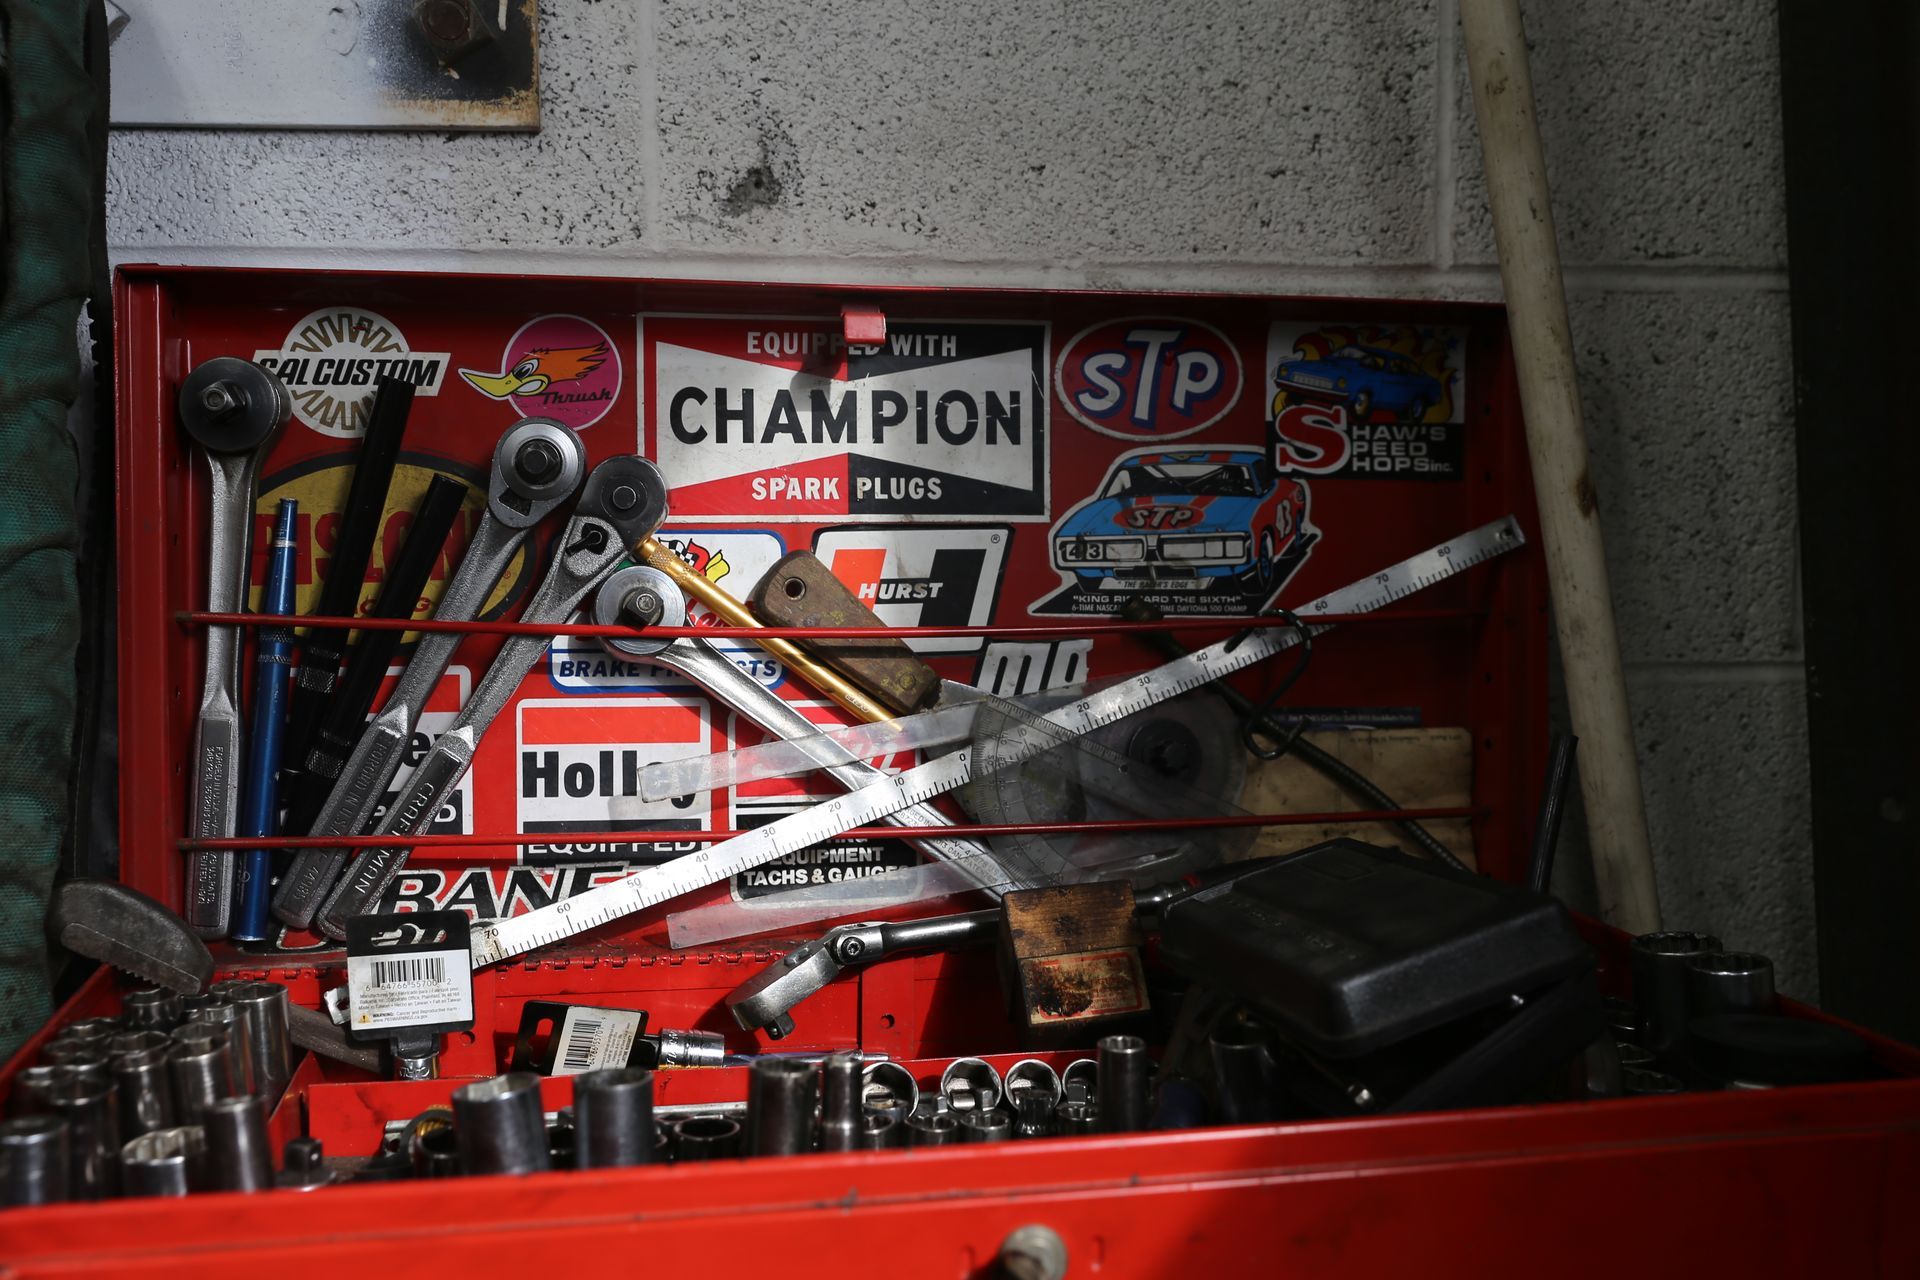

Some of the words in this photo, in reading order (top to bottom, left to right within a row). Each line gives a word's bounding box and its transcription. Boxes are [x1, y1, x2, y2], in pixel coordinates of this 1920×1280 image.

[890, 334, 957, 357] WITH
[312, 357, 441, 387] CUSTOM
[1076, 328, 1222, 424] STP
[542, 388, 612, 405] Thrush
[669, 385, 1021, 446] CHAMPION
[751, 476, 840, 500] SPARK
[856, 477, 943, 500] PLUGS
[1127, 505, 1193, 528] STP
[1275, 499, 1293, 539] 43
[1437, 545, 1452, 558] 80
[1375, 572, 1390, 585] 70
[858, 581, 943, 600] HURST
[1113, 595, 1170, 604] RIARD
[1172, 595, 1196, 604] THE
[1314, 600, 1329, 612] 60
[1096, 604, 1122, 613] NASCA
[1195, 651, 1209, 663] 40
[559, 660, 640, 678] BRAKE
[1137, 675, 1151, 687] 30
[1076, 701, 1090, 713] 20
[958, 752, 967, 763] 0
[894, 776, 905, 787] 10
[828, 801, 842, 813] 20
[355, 782, 436, 895] CRAFMAN
[762, 826, 777, 839] 30
[695, 852, 709, 864] 40
[627, 877, 642, 889] 50
[743, 868, 808, 887] TACHS
[811, 867, 825, 884] &
[556, 902, 572, 914] 60
[484, 927, 499, 939] 70
[381, 982, 408, 991] 64766
[411, 979, 438, 989] 55700
